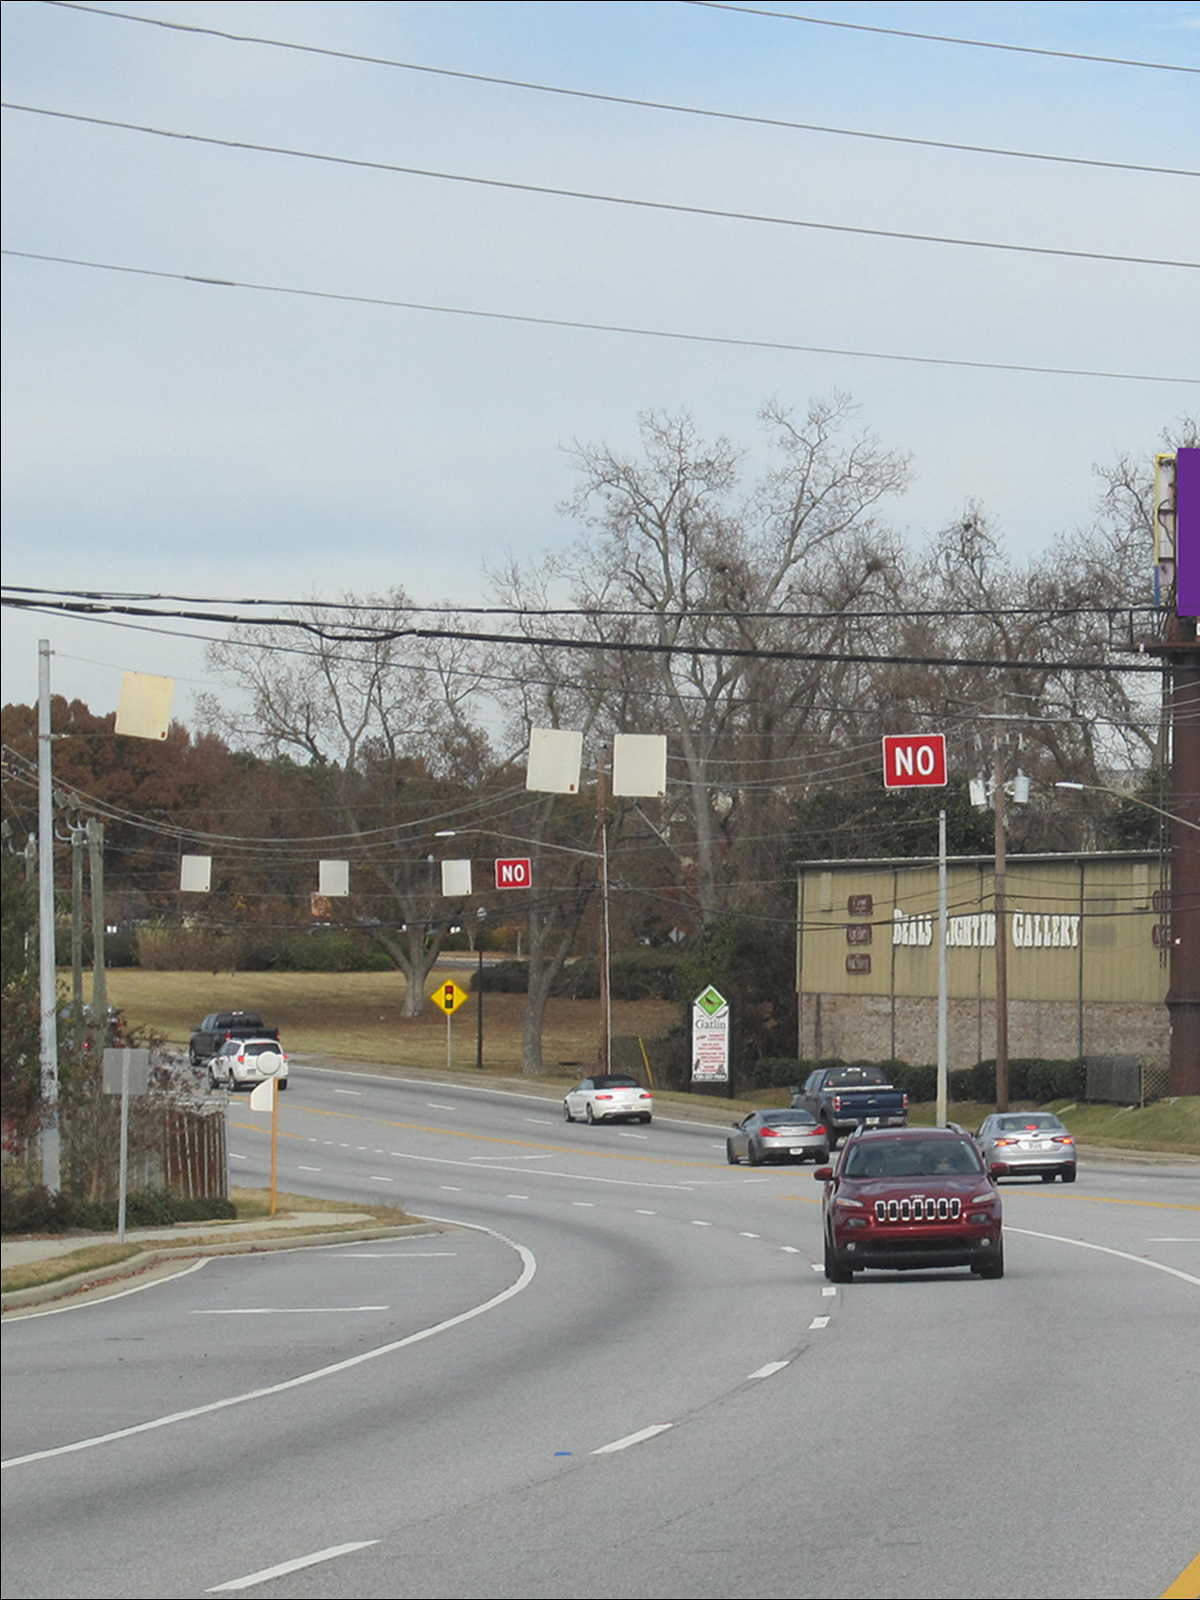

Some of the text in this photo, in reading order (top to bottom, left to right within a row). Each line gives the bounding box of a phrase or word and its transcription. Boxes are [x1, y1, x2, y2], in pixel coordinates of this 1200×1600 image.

[895, 745, 935, 776] NO
[502, 864, 525, 882] NO
[946, 910, 996, 947] IGHTIN
[1012, 909, 1081, 948] GALLERY
[695, 1020, 726, 1030] Gatlin
